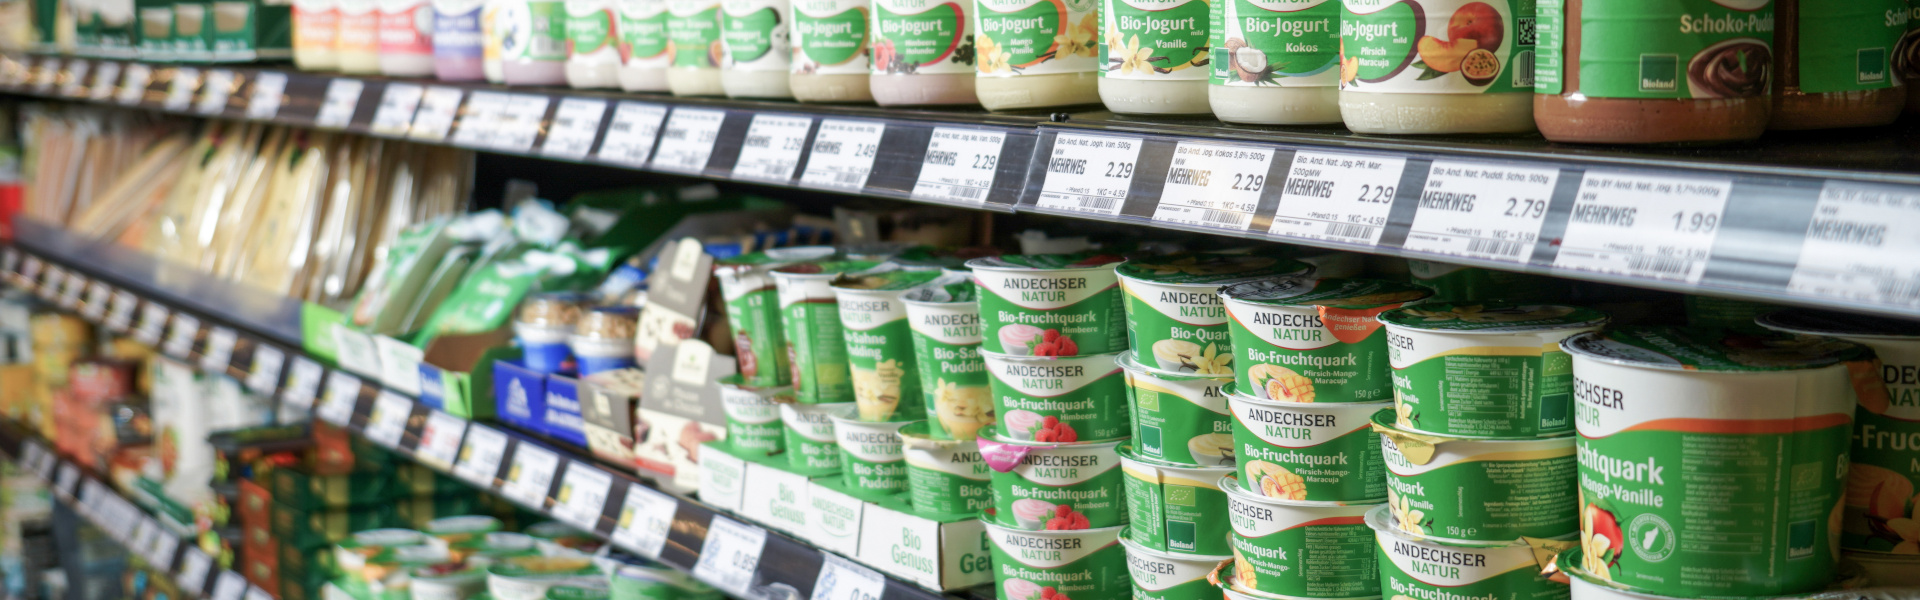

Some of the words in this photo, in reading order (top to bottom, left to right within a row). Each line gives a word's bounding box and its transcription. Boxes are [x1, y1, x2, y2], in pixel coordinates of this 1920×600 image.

[798, 21, 852, 37] Bio-Jogurt
[882, 19, 943, 36] Bio-Jogurt
[983, 16, 1044, 34] Bio-Jogurt
[1120, 16, 1195, 34] Bio-Jogurt
[1246, 17, 1330, 37] Bio-Jogurt
[1342, 20, 1398, 42] Bio-Jogurt
[905, 39, 937, 47] Himbeere
[1010, 38, 1033, 47] Mango
[1155, 39, 1187, 48] Vanille
[1285, 42, 1319, 53] Kokos
[905, 47, 936, 55] Holunder
[1010, 46, 1034, 54] Vanille
[1360, 46, 1387, 56] Pfirsich
[1358, 57, 1390, 69] Maracuja
[1642, 78, 1675, 90] Bioland
[989, 136, 1001, 144] 500g
[1117, 141, 1132, 150] 500g
[854, 143, 876, 158] 2.49
[924, 149, 958, 166] MEHRWEG
[1177, 146, 1187, 154] Bio
[1188, 147, 1201, 156] And.
[1214, 149, 1233, 158] Kokos
[1249, 152, 1265, 162] 500g
[972, 154, 997, 170] 2.29
[1048, 156, 1088, 175] MEHRWEG
[1174, 158, 1186, 166] MW
[1309, 156, 1323, 166] And.
[1325, 157, 1339, 167] Nat.
[1340, 159, 1353, 169] Jog.
[1367, 161, 1383, 170] Mar.
[1104, 161, 1133, 179] 2.29
[1293, 167, 1322, 178] 500gMW
[1432, 166, 1445, 176] Bio
[1445, 167, 1462, 177] And.
[1463, 169, 1478, 179] Nat.
[1506, 172, 1526, 182] Scho.
[1528, 173, 1549, 186] 500g
[1166, 167, 1212, 188] MEHRWEG
[1231, 172, 1264, 192] 2.29
[1428, 179, 1443, 188] MW
[1586, 177, 1600, 188] Bio
[1615, 179, 1633, 191] And.
[1096, 188, 1108, 196] 1KG
[1112, 189, 1126, 198] 4.58
[1284, 177, 1335, 199] MEHRWEG
[1357, 183, 1395, 205] 2.29
[1419, 189, 1477, 214] MEHRWEG
[1581, 191, 1598, 201] MW
[1221, 201, 1235, 210] 1KG
[1240, 203, 1256, 212] 4.58
[1503, 196, 1546, 220] 2.79
[1347, 213, 1362, 224] 1KG
[1368, 215, 1386, 226] 4.58
[1571, 203, 1638, 228] MEHRWEG
[1671, 210, 1718, 234] 1.99
[1492, 229, 1508, 240] 1KG
[1516, 231, 1536, 243] 5.58
[1806, 217, 1888, 247] MEHRWEG
[1003, 277, 1087, 290] ANDECHSER
[1021, 291, 1066, 302] NATUR
[998, 310, 1097, 327] Bio-Fruchtquark
[1179, 306, 1226, 318] NATUR
[1322, 313, 1361, 324] Andechser
[1253, 311, 1325, 328] ANDECHS
[1062, 326, 1098, 335] Himbeere
[1272, 327, 1323, 342] NATUR
[1333, 323, 1368, 332] genießen
[1248, 347, 1357, 370] Bio-Fruchtquark
[1006, 364, 1084, 378] ANDECHSER
[1303, 369, 1359, 378] Pfirsich-Mango-
[1022, 378, 1064, 390] NATUR
[1314, 377, 1348, 386] Maracuja
[1354, 389, 1368, 399] 150
[1367, 391, 1372, 399] g
[1401, 391, 1420, 405] Vanille
[1574, 376, 1624, 411] ECHSER
[1002, 395, 1096, 413] Bio-Fruchtquark
[1060, 412, 1098, 421] Himbeere
[1248, 408, 1336, 427] ANDECHSER
[1541, 418, 1566, 428] Bioland
[1265, 424, 1312, 440] NATUR
[1244, 442, 1348, 468] Bio-Fruchtquark
[1035, 467, 1078, 479] NATUR
[1295, 467, 1351, 477] Pfirsich-Mango-
[1306, 476, 1340, 484] Maracuja
[779, 482, 795, 502] Bio
[1011, 484, 1108, 500] Bio-Fruchtquark
[1581, 471, 1664, 508] Mango-Vanille
[812, 496, 855, 523] ANDECHSER
[1074, 501, 1110, 510] Himbeere
[1408, 498, 1434, 511] Vanille
[770, 498, 806, 526] Genuss
[822, 511, 846, 531] NATUR
[902, 526, 922, 551] Bio
[1446, 526, 1460, 536] 150
[1460, 527, 1467, 538] g
[1006, 534, 1082, 549] ANDECHSER
[1169, 538, 1195, 550] Bioland
[891, 543, 934, 576] Genuss
[1021, 548, 1062, 561] NATUR
[1393, 540, 1487, 567] ANDECHSER
[732, 550, 756, 573] 0.85
[1002, 563, 1093, 584] Bio-Fruchtquark
[1255, 565, 1281, 578] Maracuja
[1411, 560, 1460, 580] NATUR
[1058, 583, 1096, 592] Himbeere
